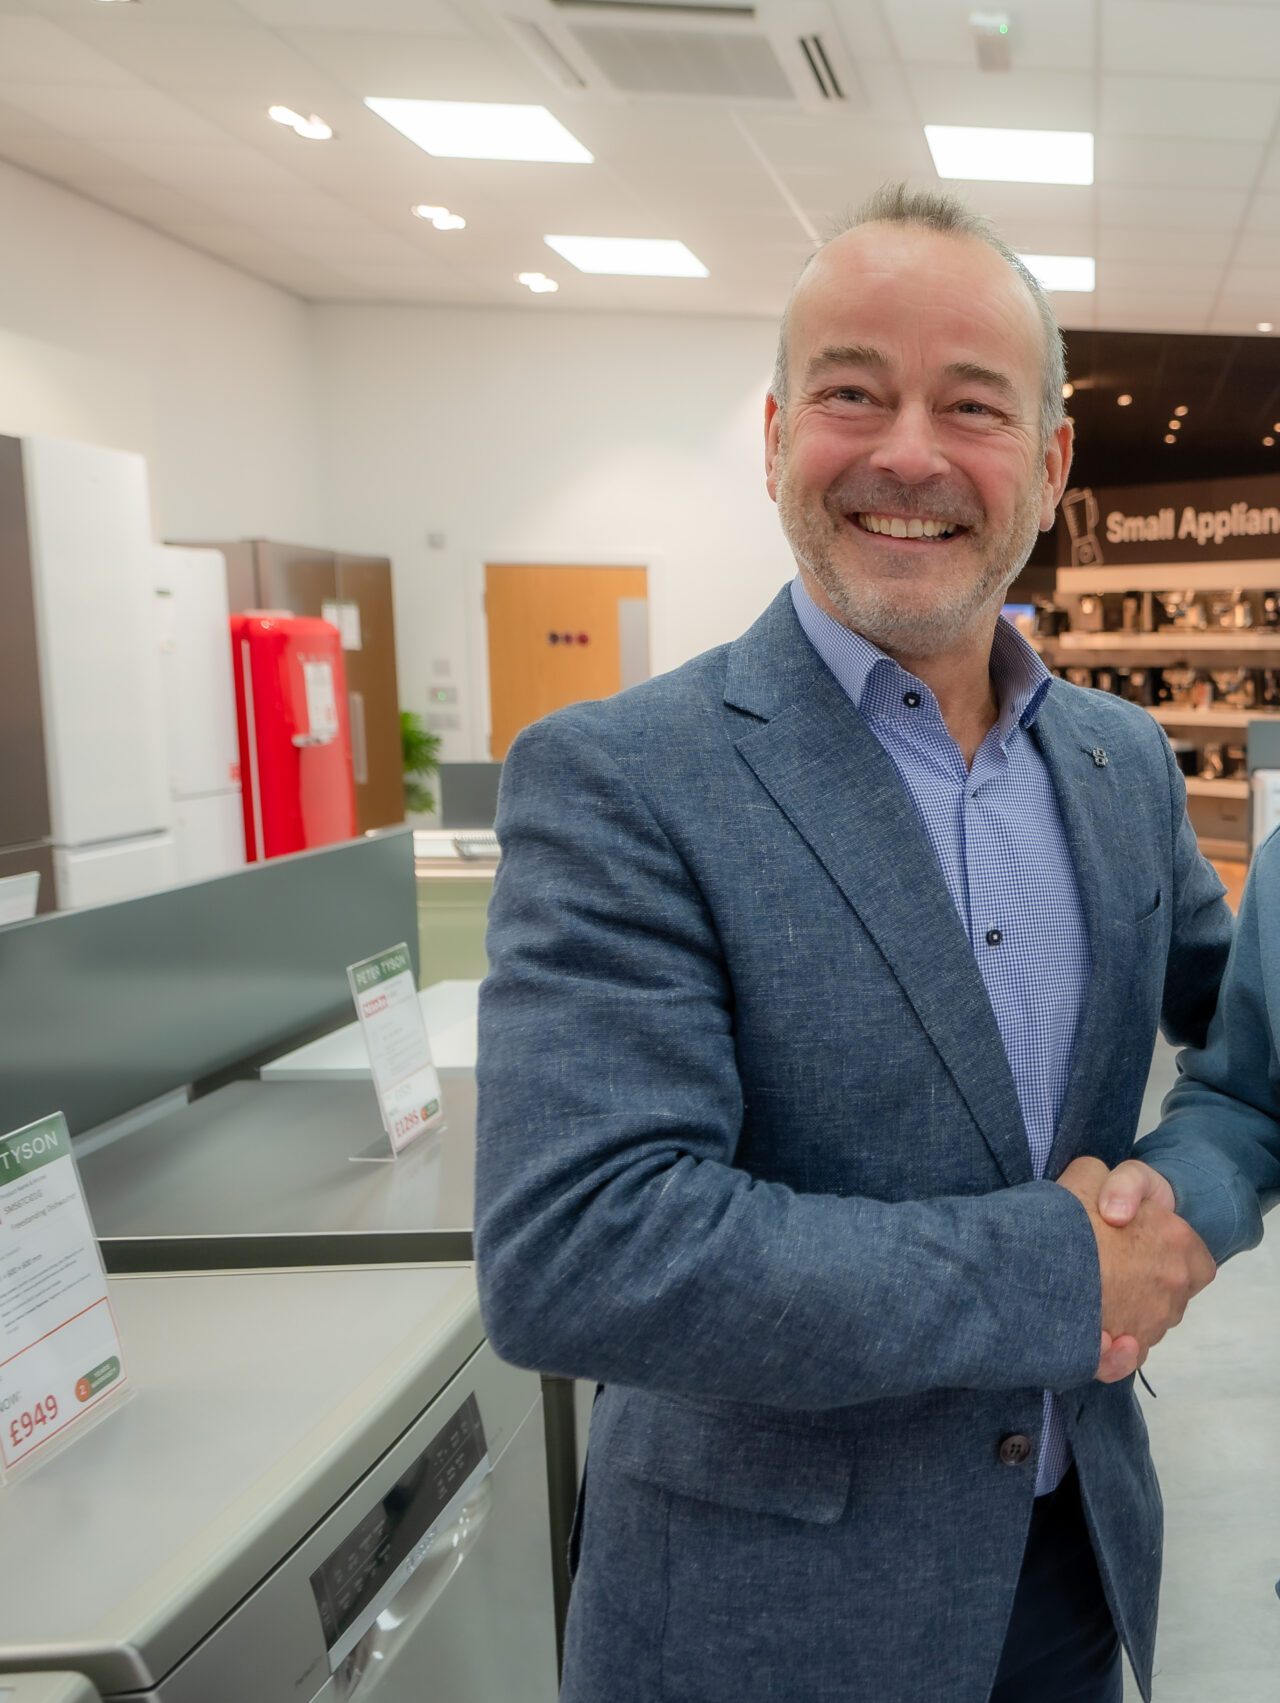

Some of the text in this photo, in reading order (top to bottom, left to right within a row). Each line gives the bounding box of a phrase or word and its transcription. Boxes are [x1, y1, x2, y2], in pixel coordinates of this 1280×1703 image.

[1106, 507, 1175, 543] Small
[0, 1131, 58, 1169] TYSON
[10, 1395, 58, 1447] £949
